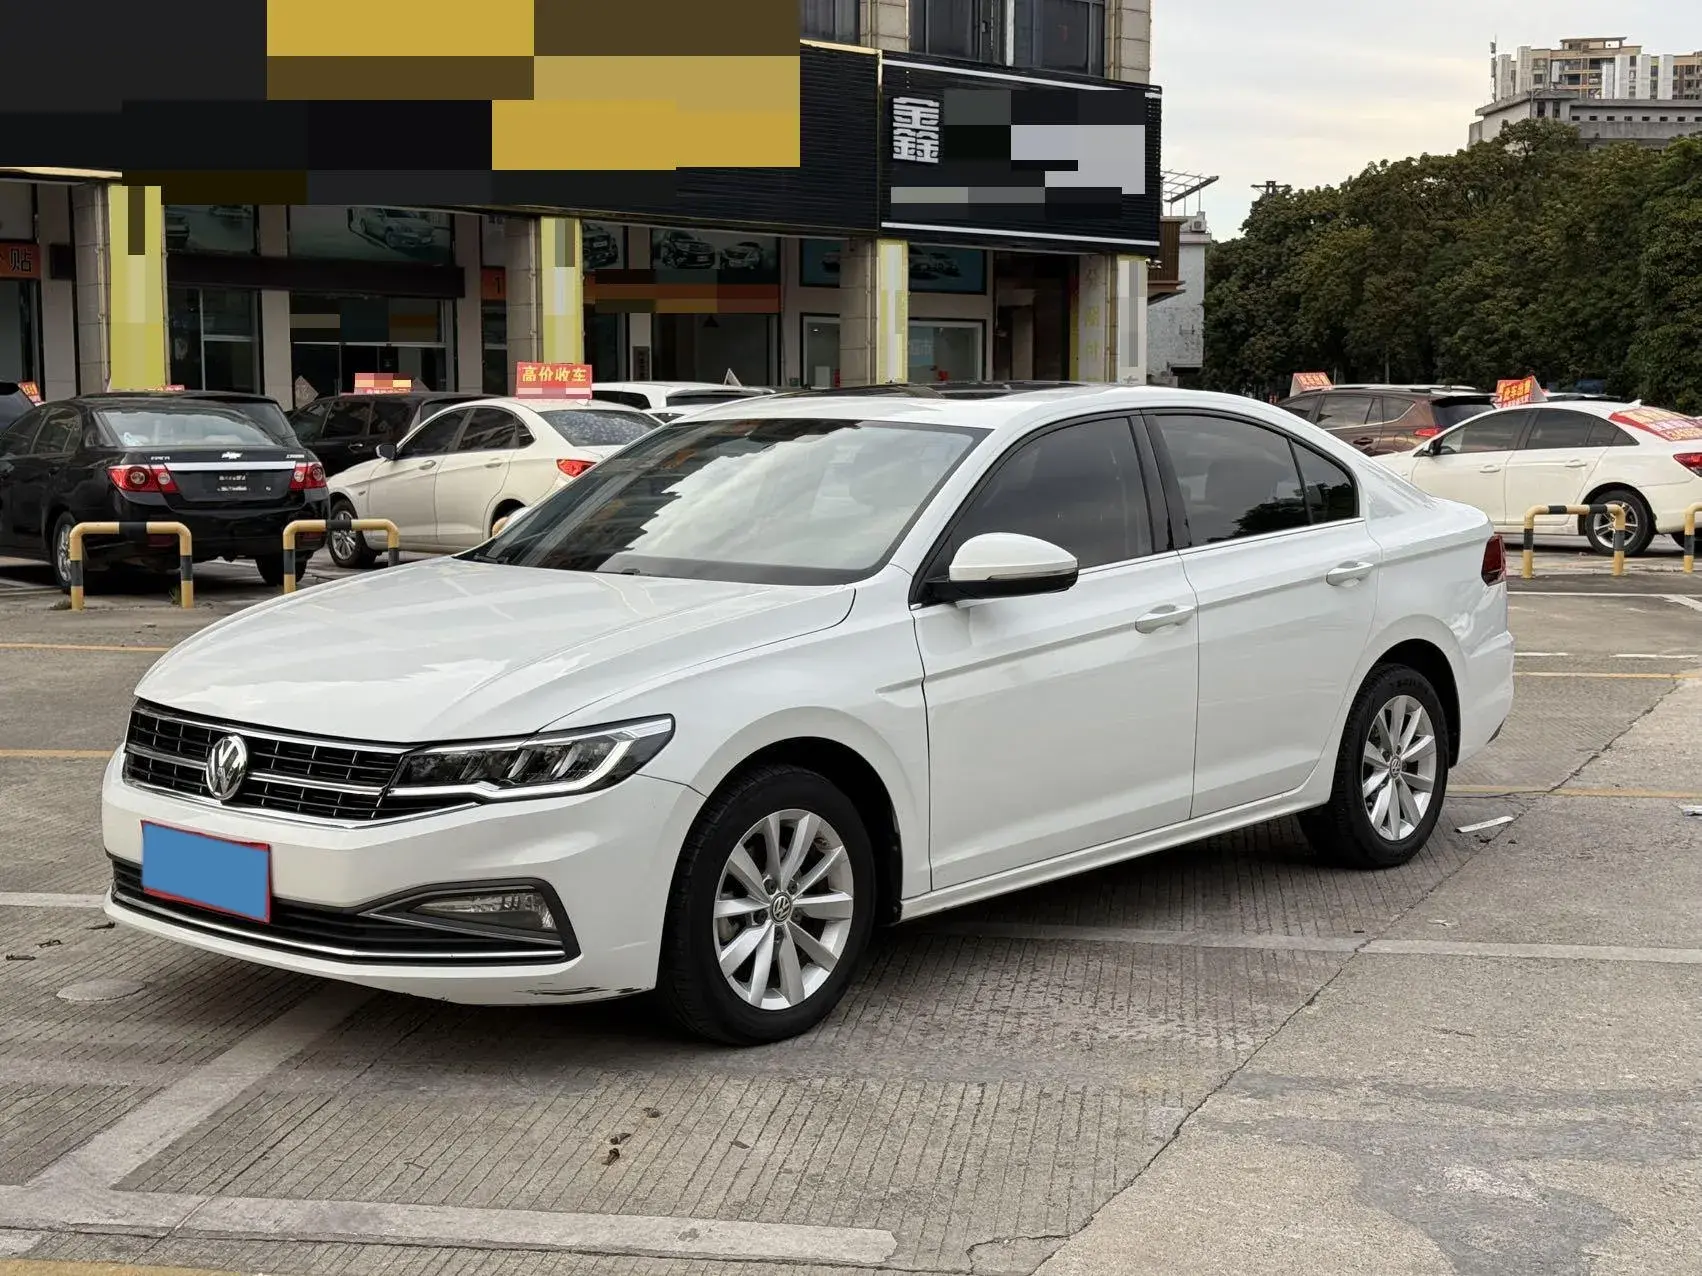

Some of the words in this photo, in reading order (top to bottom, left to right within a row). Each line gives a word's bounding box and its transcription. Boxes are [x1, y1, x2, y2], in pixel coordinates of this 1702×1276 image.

[892, 96, 939, 163] 鑫
[521, 365, 587, 382] 高价收车
